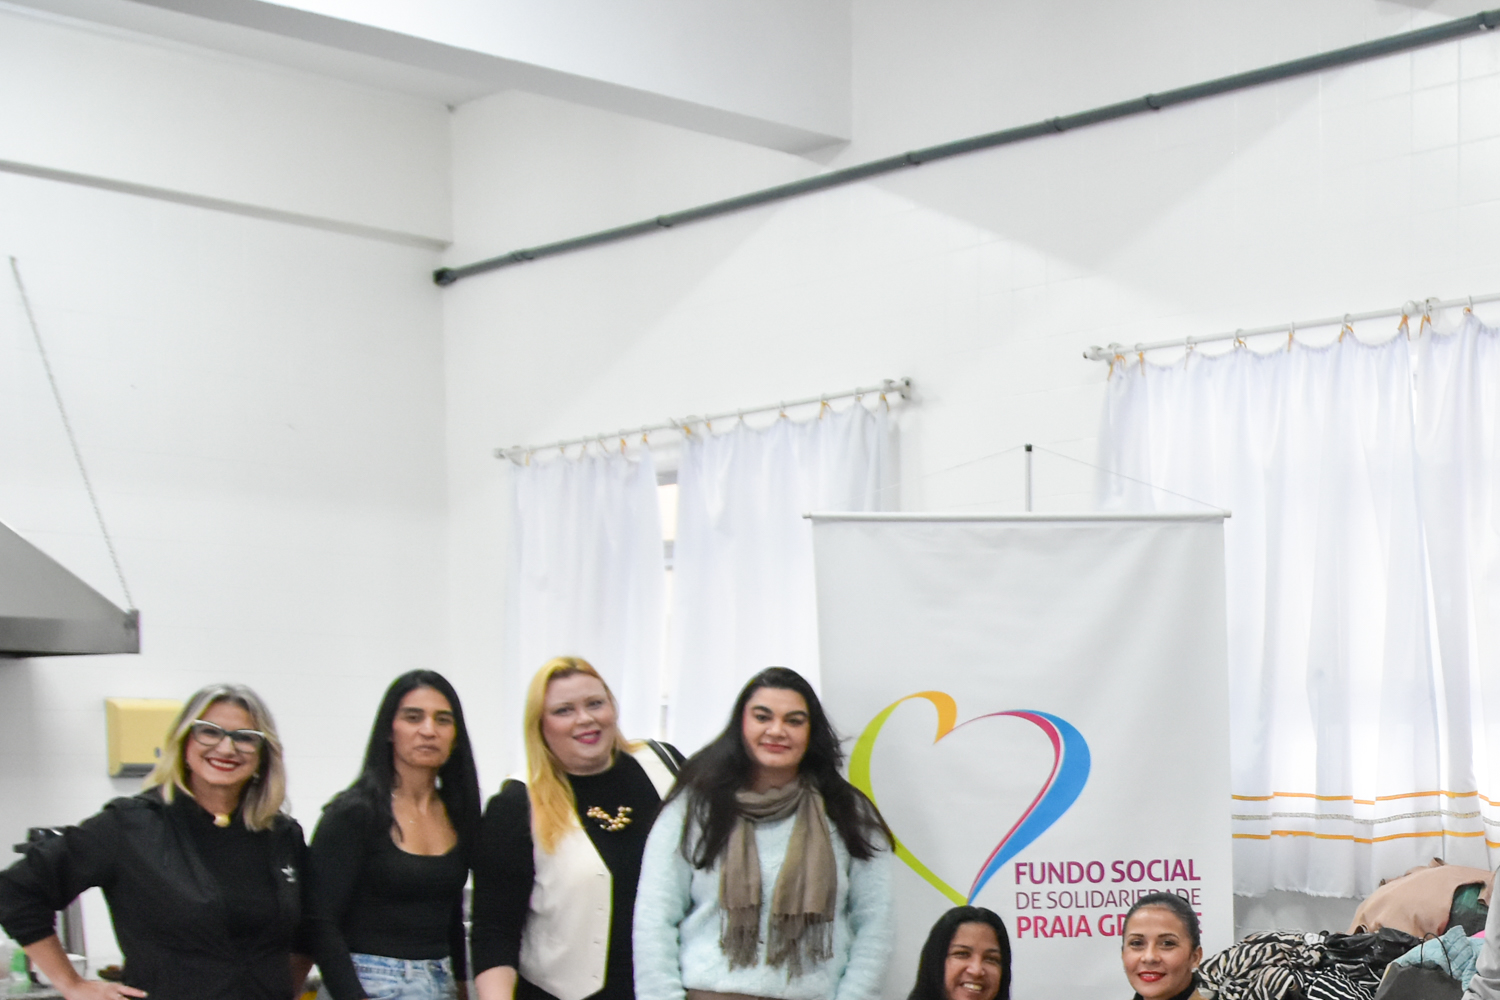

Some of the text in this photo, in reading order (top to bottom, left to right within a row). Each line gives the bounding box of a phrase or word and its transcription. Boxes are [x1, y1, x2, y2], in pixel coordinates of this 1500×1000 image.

[1015, 859, 1201, 884] FUNDO SOCIAL
[1016, 888, 1202, 909] DE SOLIDARIEDE
[1017, 914, 1093, 938] PRAIA
